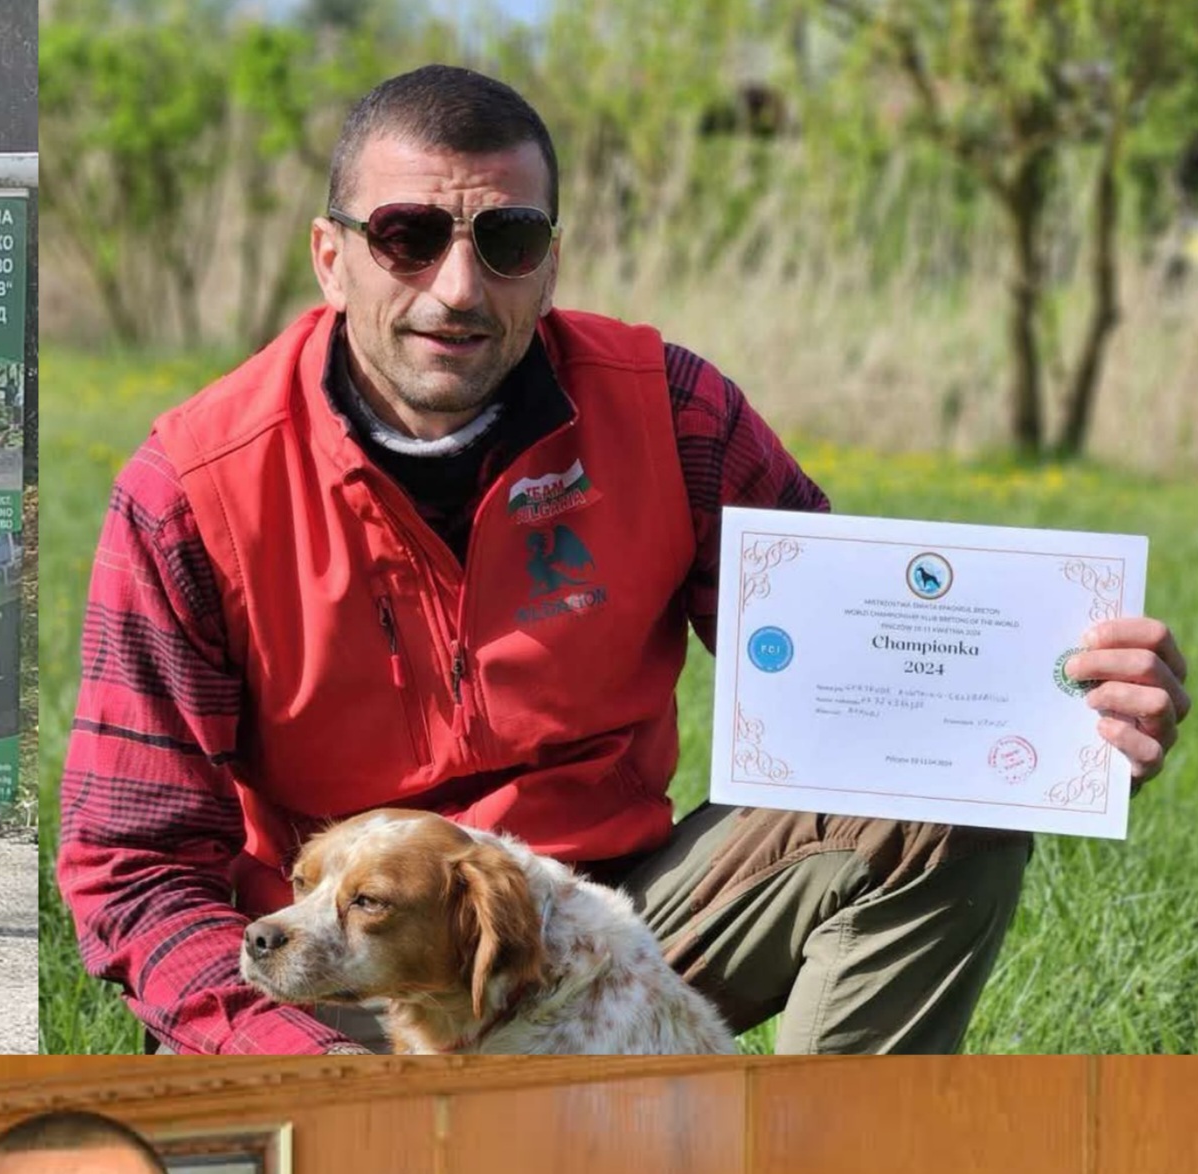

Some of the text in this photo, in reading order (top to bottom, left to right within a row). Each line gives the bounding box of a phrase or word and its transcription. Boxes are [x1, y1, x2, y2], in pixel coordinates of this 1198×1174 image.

[526, 479, 565, 499] TEAM
[871, 634, 980, 656] Championka
[903, 660, 945, 676] 2024
